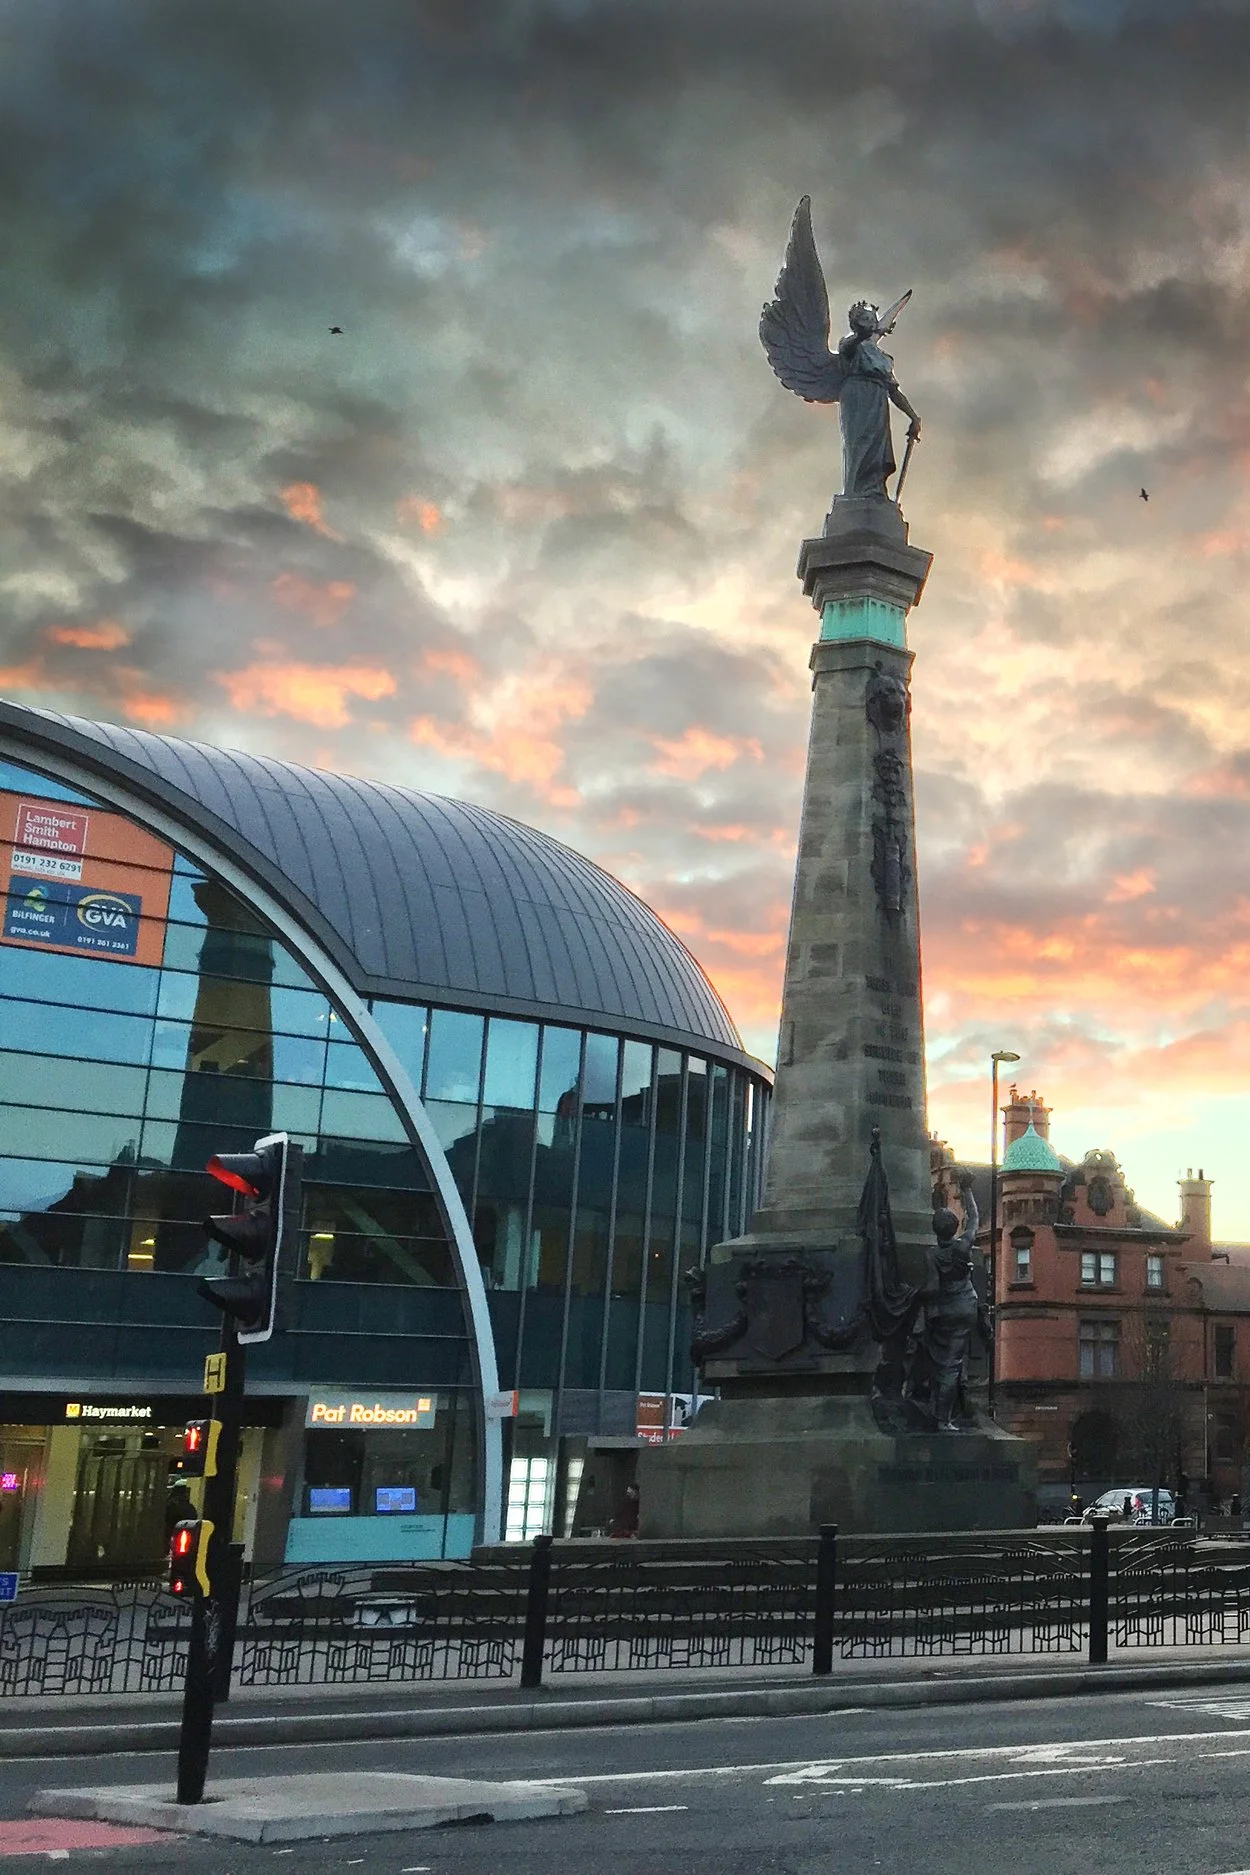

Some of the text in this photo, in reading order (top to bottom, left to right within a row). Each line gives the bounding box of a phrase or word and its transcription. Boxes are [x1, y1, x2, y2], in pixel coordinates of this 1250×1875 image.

[24, 822, 59, 838] Smith
[26, 811, 77, 830] Lambert
[23, 833, 77, 852] Hampton
[13, 854, 36, 865] 0191
[39, 858, 57, 869] 232
[59, 862, 81, 873] 6291
[85, 903, 127, 928] GVA
[77, 936, 95, 945] 0191
[206, 1357, 222, 1390] H
[81, 1405, 152, 1419] Haymarket
[311, 1403, 418, 1424] Pat Robson
